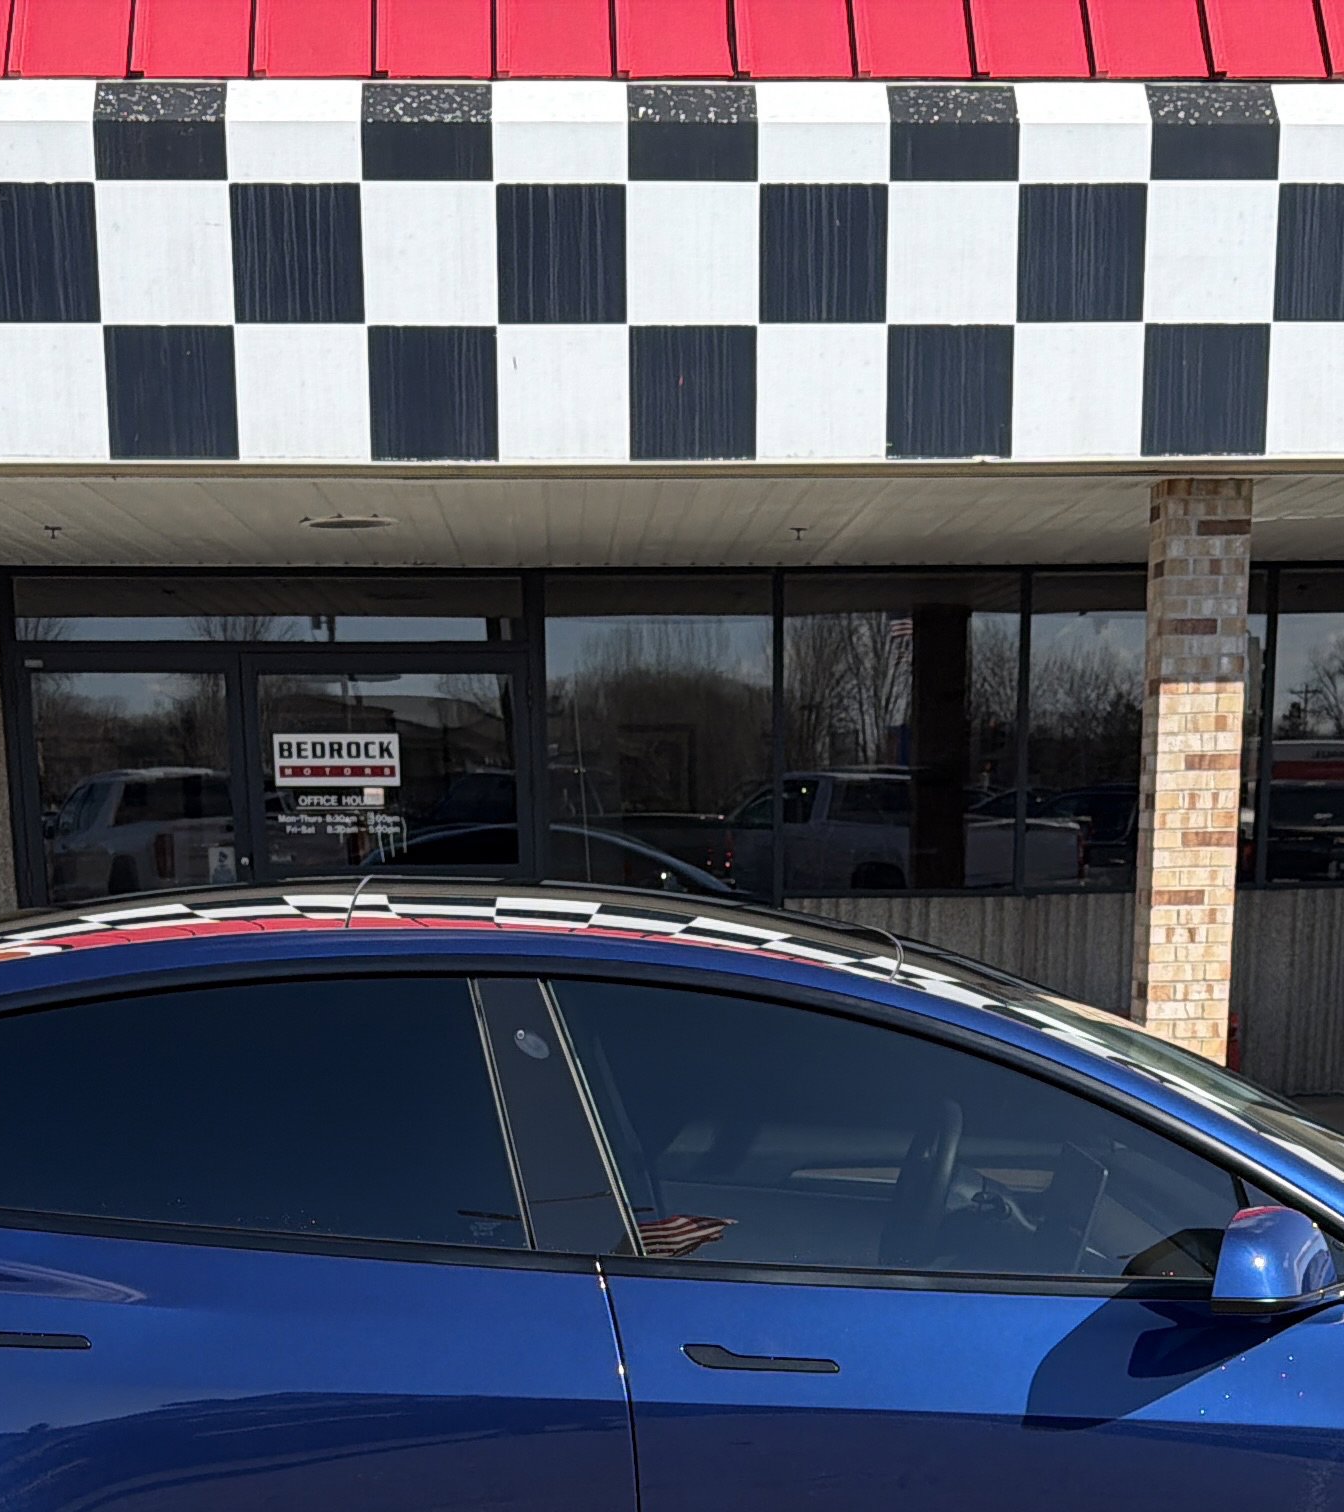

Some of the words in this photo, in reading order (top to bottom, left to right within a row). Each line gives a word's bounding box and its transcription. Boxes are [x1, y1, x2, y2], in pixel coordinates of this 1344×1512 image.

[278, 741, 394, 759] BEDROCK
[284, 767, 391, 776] MOTORS
[298, 795, 339, 806] OFFICE
[342, 795, 372, 806] HOU
